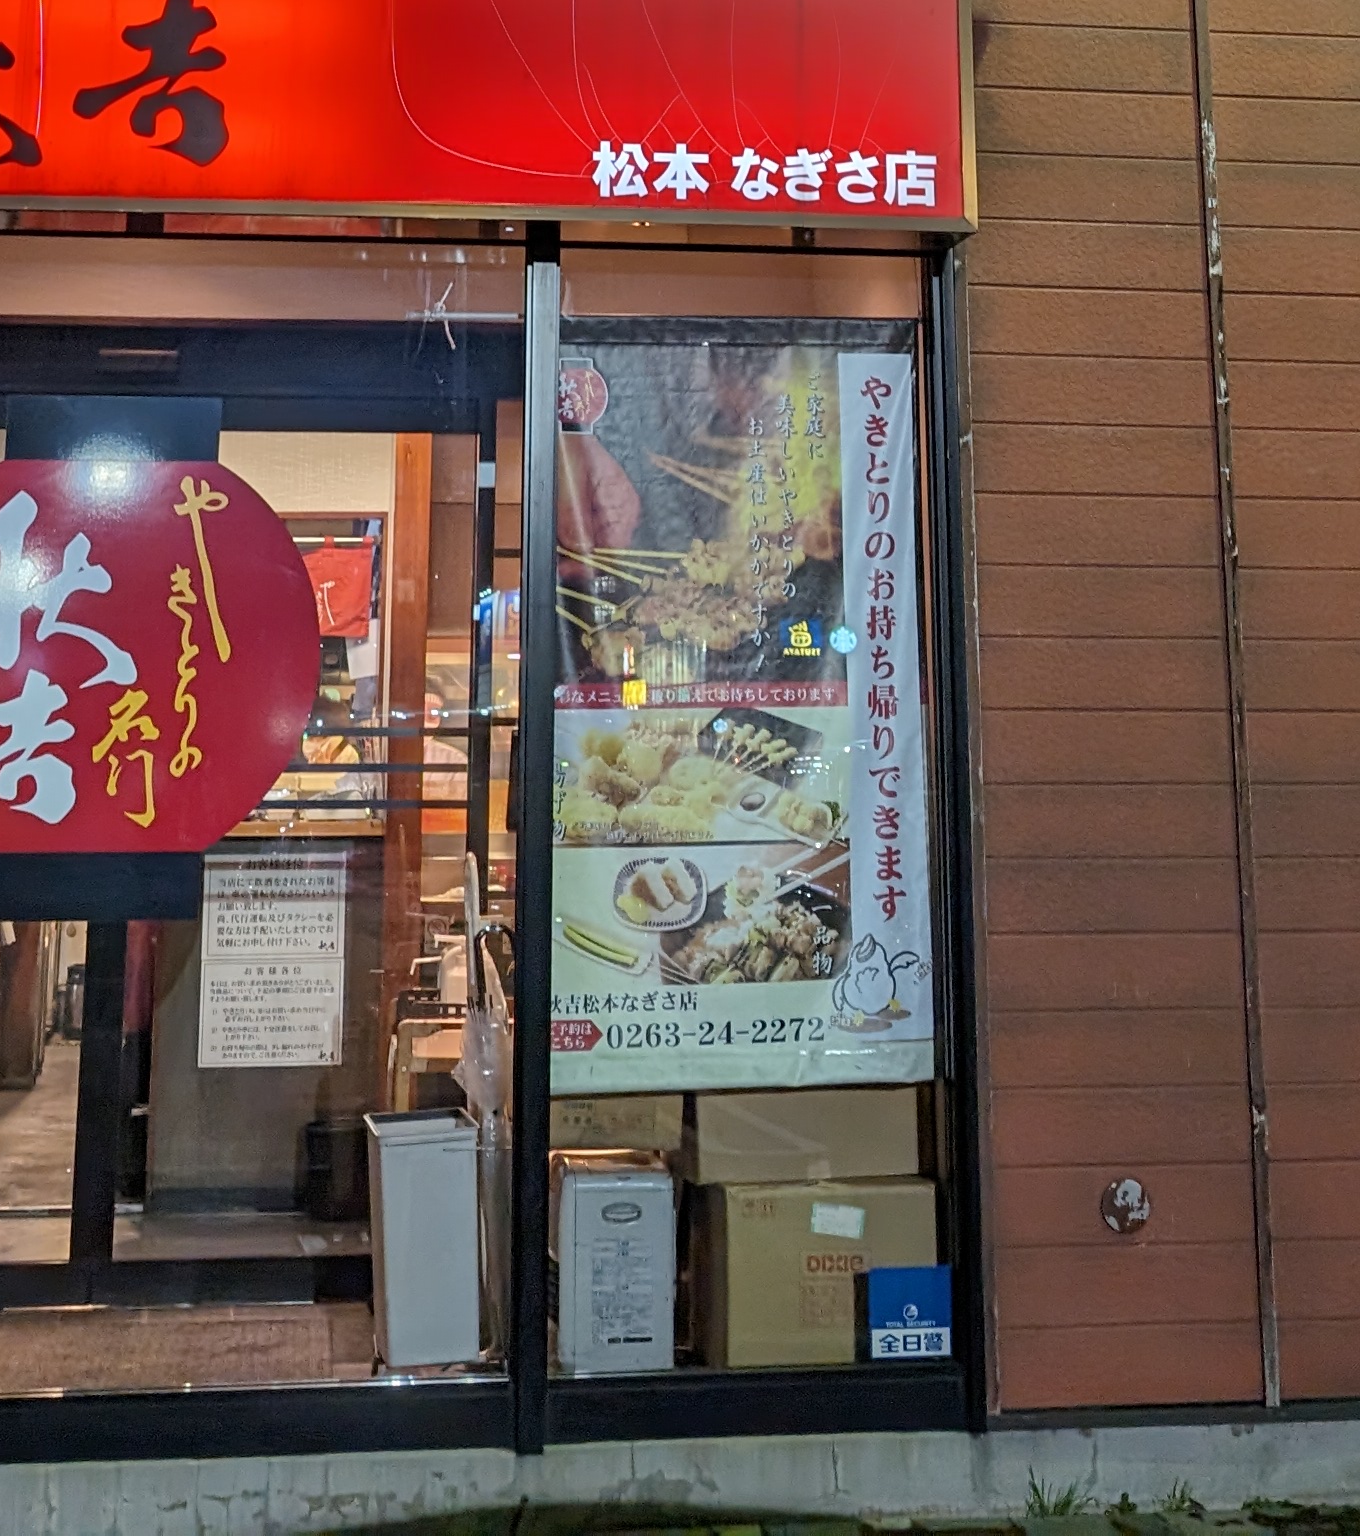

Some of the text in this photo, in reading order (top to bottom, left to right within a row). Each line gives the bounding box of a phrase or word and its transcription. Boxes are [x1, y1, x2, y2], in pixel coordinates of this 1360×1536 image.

[591, 138, 939, 206] 松本 なぎさ店
[803, 372, 826, 459] ご家庭に
[778, 394, 797, 598] 美味しいやきとりの
[860, 376, 907, 923] やきとりのお持ち帰りできます
[606, 1017, 825, 1050] 0263-24-2272
